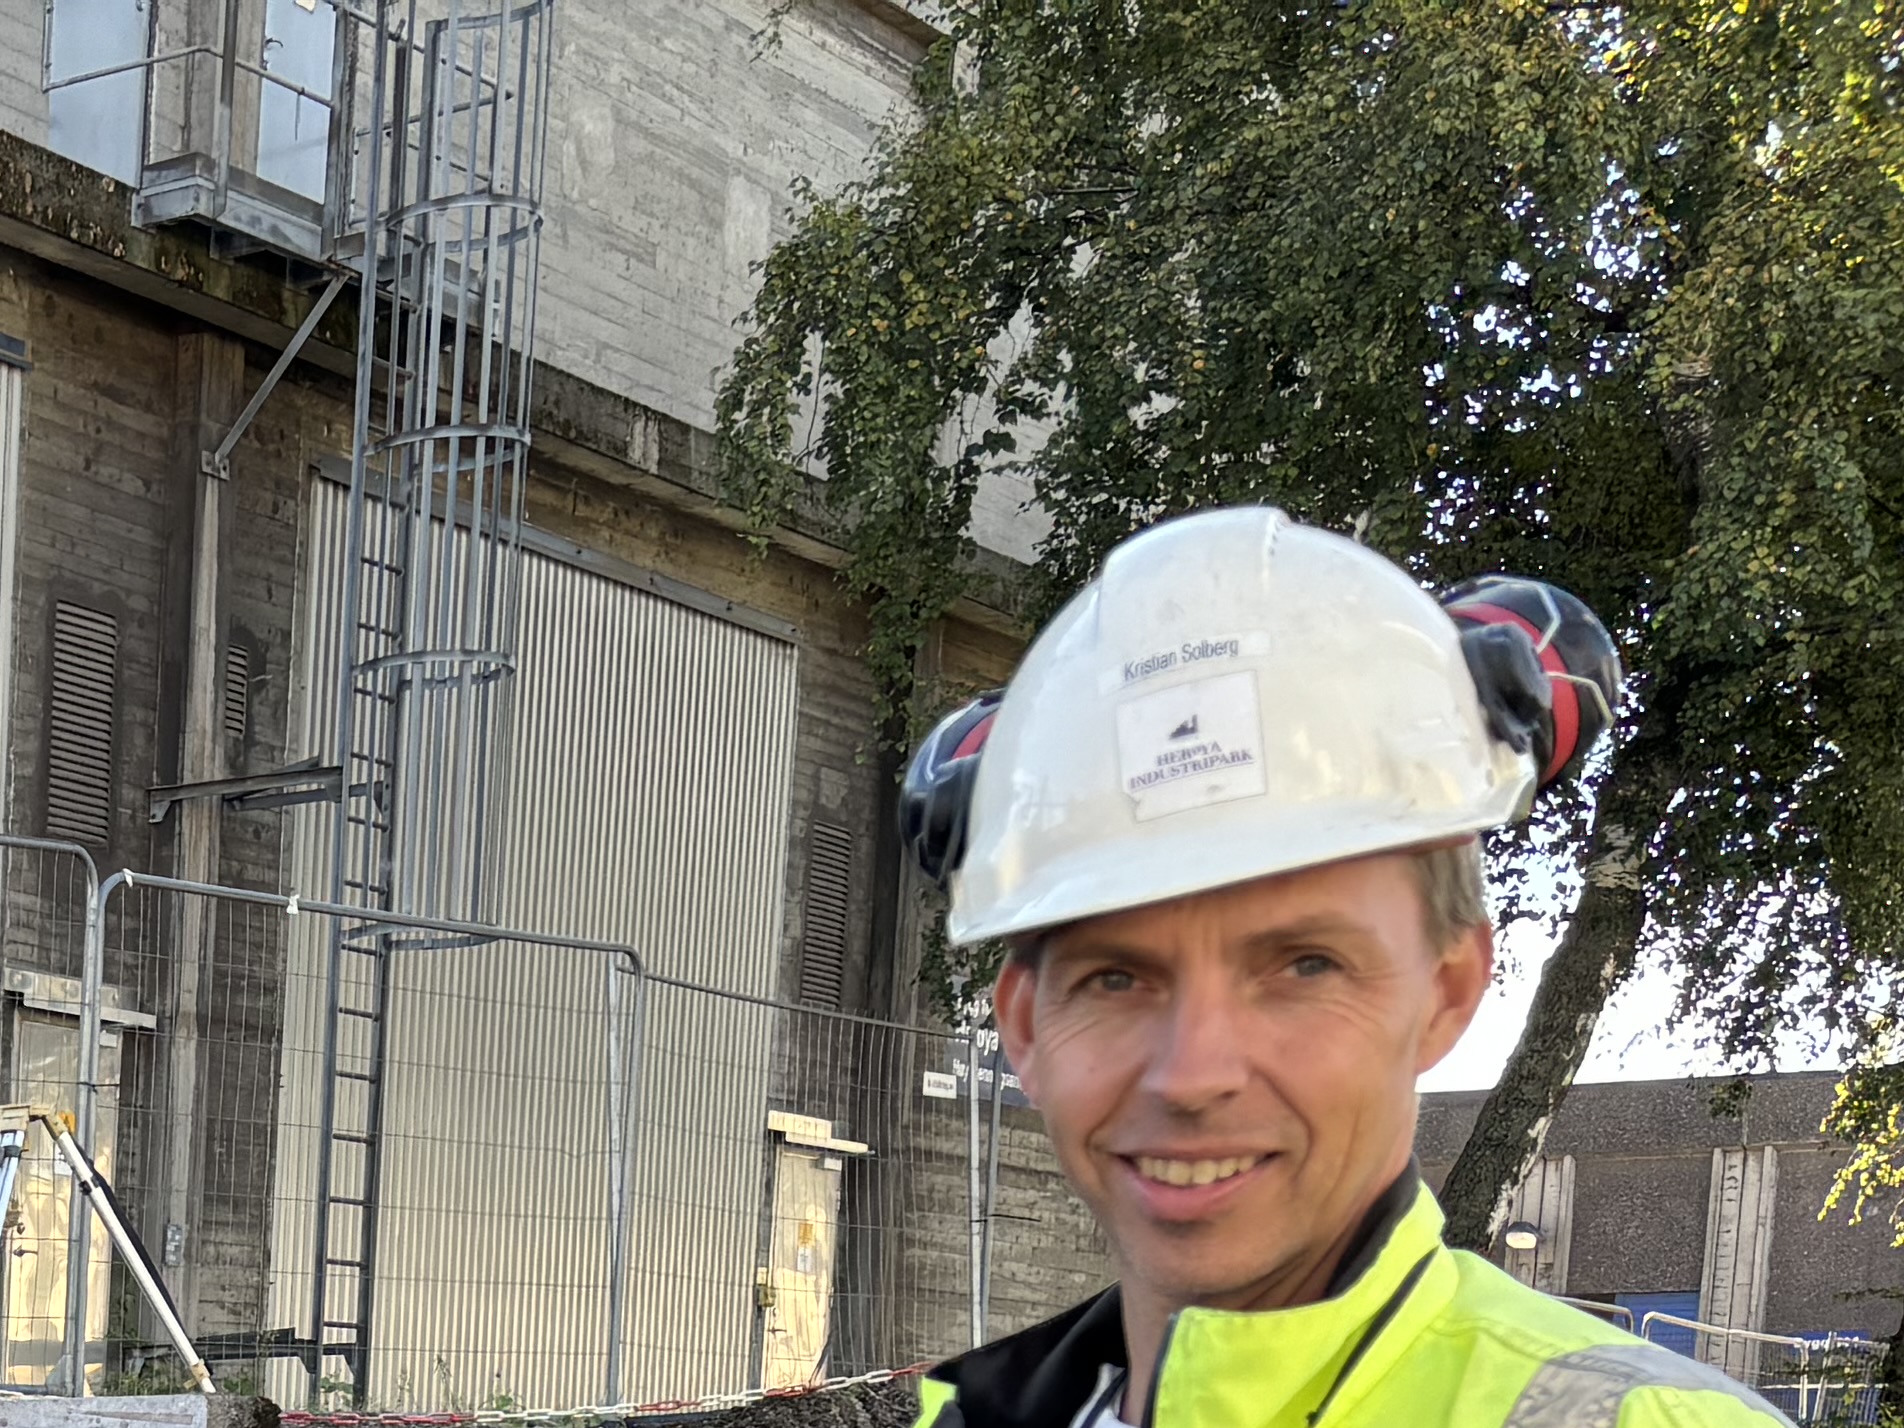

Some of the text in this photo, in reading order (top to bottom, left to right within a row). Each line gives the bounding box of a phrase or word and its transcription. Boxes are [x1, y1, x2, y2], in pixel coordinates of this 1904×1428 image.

[1124, 639, 1239, 681] Kristian Solberg
[1129, 749, 1254, 790] INDUSTRIPARK
